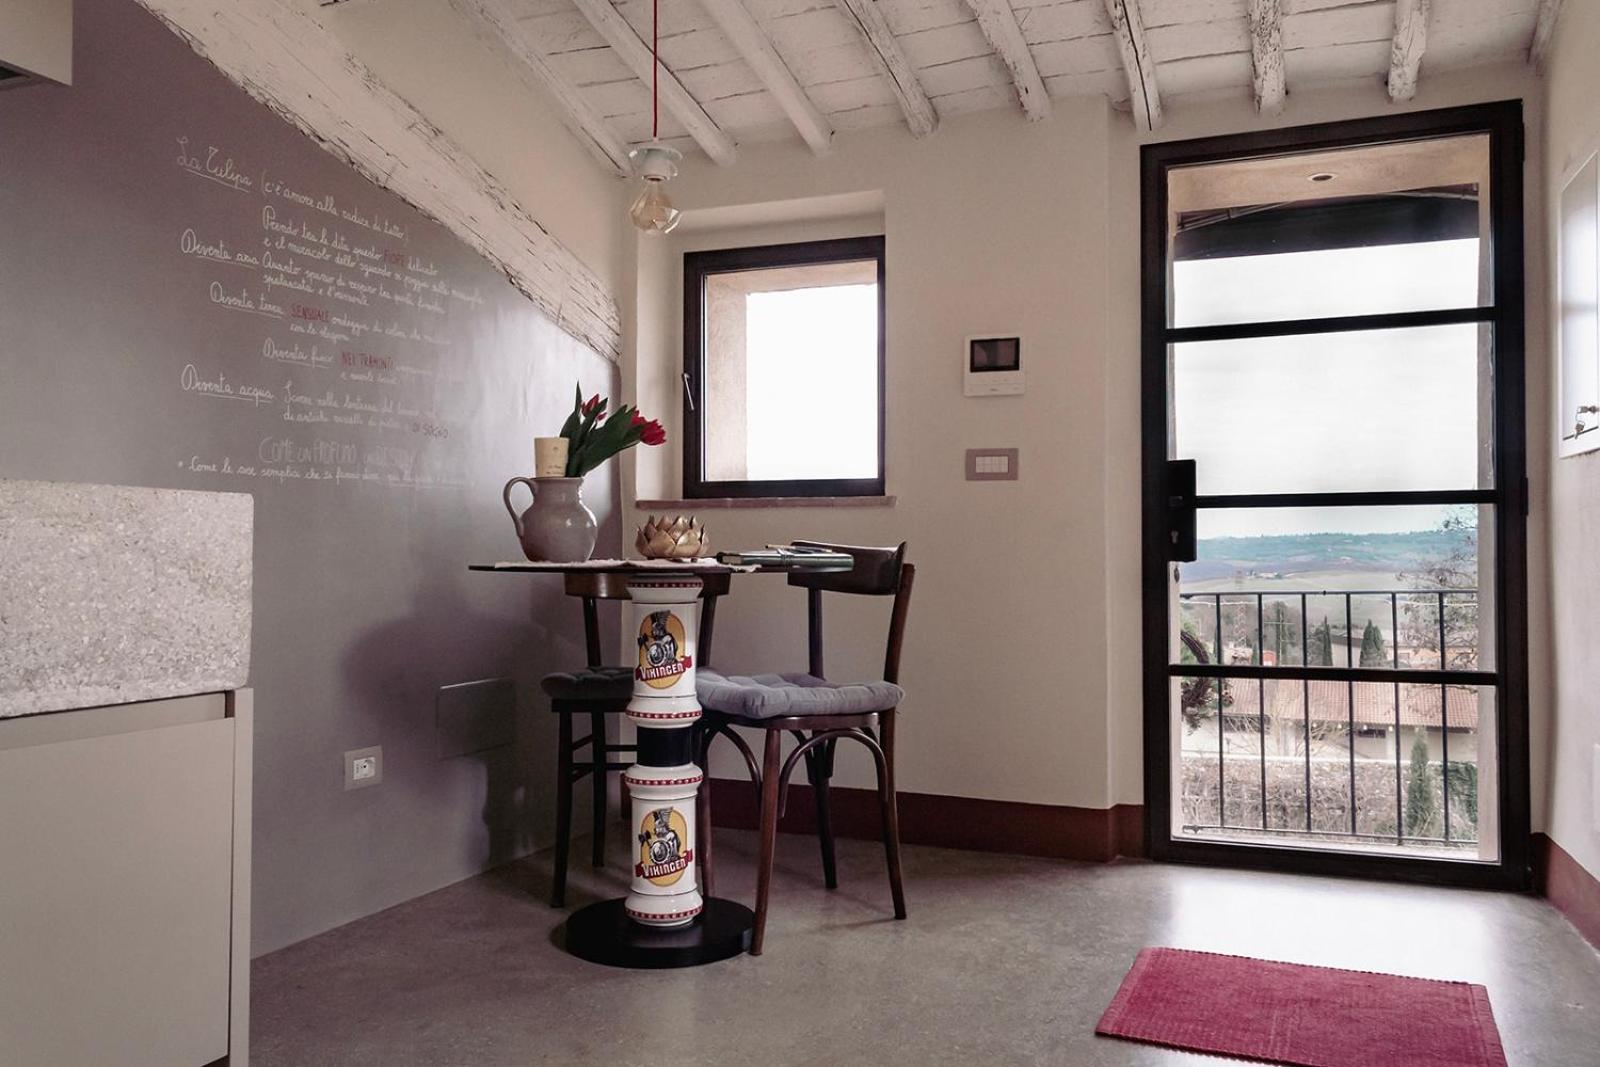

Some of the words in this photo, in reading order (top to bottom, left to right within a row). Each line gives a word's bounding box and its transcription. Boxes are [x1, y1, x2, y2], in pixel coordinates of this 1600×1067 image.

[176, 136, 202, 170] La
[206, 146, 252, 188] Tulipa
[316, 195, 338, 216] alla
[181, 228, 231, 259] Diventa
[262, 205, 298, 236] Prendo
[302, 221, 317, 242] tra
[320, 227, 329, 245] le
[331, 232, 349, 251] dita
[352, 246, 382, 262] questo
[264, 238, 271, 247] e
[275, 236, 285, 249] il
[288, 242, 331, 260] miracolo
[210, 281, 255, 309] Diventa
[289, 303, 329, 323] SENSUALE
[262, 338, 307, 360] Diventa
[181, 364, 233, 393] Diventa
[239, 385, 274, 407] acqua
[189, 455, 217, 472] Come
[222, 457, 233, 473] le
[304, 467, 321, 480] che
[640, 662, 684, 680] VIKINGER
[641, 858, 686, 877] VIKINGER
